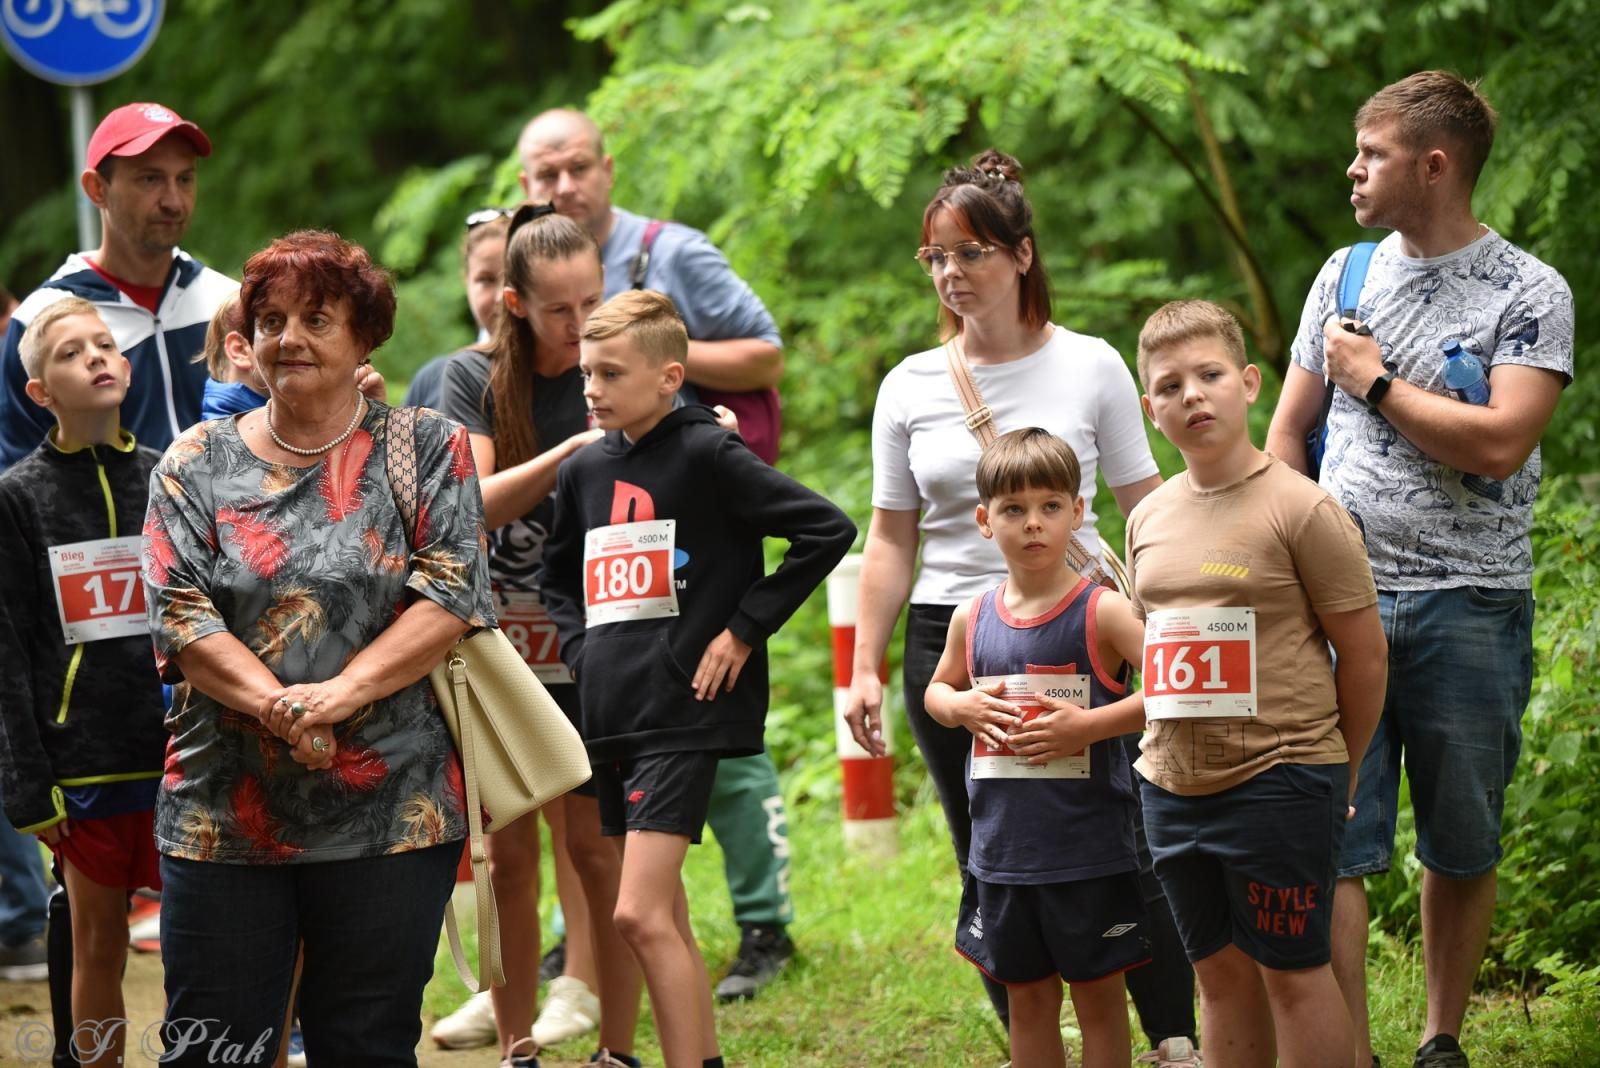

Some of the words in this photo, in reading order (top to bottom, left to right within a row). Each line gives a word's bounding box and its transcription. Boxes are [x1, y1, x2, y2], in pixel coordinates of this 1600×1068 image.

[637, 534, 658, 545] 4500
[658, 533, 669, 543] M
[61, 550, 85, 562] Bieg
[593, 555, 653, 601] 180
[83, 571, 138, 615] 17
[1207, 622, 1235, 633] 4500
[1237, 622, 1248, 631] M
[1152, 645, 1228, 691] 161
[1044, 688, 1071, 699] 4500
[1072, 688, 1083, 698] M
[1248, 882, 1318, 911] STYLE
[1257, 909, 1308, 936] NEW
